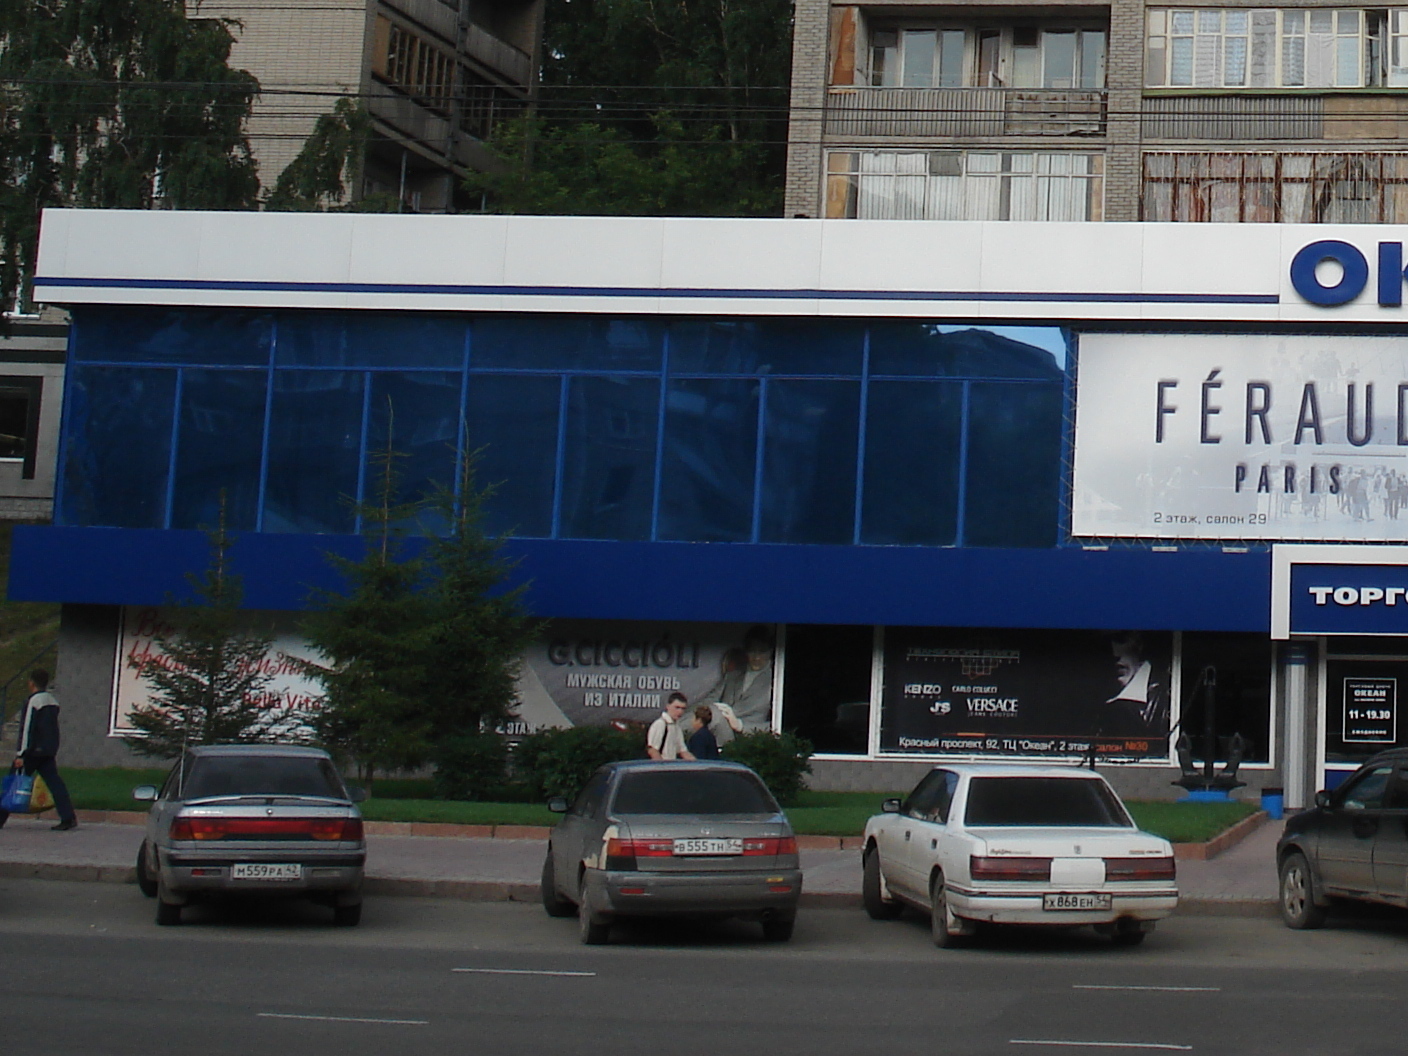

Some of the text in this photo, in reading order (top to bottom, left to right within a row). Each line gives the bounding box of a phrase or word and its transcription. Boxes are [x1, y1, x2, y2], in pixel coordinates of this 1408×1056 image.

[1235, 464, 1342, 494] PARIS
[1153, 512, 1267, 525] 2 этаж, салон 29
[566, 673, 681, 690] МУЖСКАЯ ОБУВЬ
[904, 683, 942, 695] KENZO
[584, 692, 661, 709] ИЗ ИТАЛИИ
[1353, 689, 1387, 697] ОКЕАН
[966, 697, 1019, 712] VERSACE
[1348, 709, 1359, 719] 11
[1365, 710, 1391, 720] 19.30
[898, 737, 940, 748] Красный
[1002, 740, 1017, 752] ТЦ
[1058, 741, 1066, 751] 2
